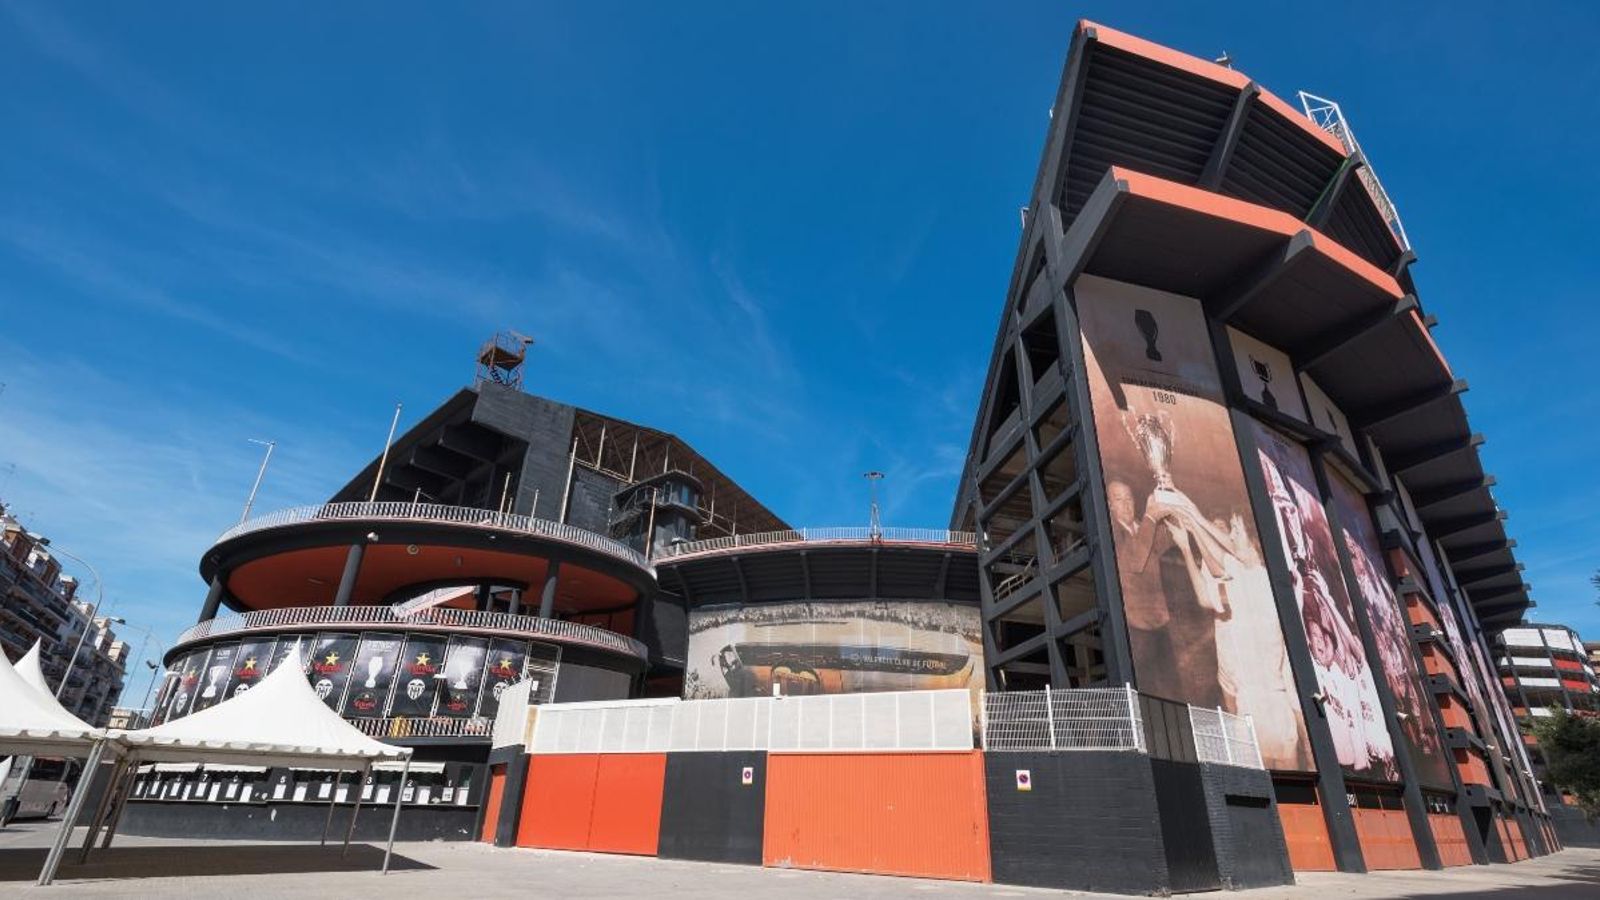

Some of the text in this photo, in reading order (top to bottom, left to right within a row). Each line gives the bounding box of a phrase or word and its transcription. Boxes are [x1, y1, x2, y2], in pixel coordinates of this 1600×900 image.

[1152, 390, 1177, 405] 1980
[202, 774, 209, 782] 7
[366, 776, 373, 784] 3
[407, 779, 414, 787] 2
[448, 779, 453, 787] 1
